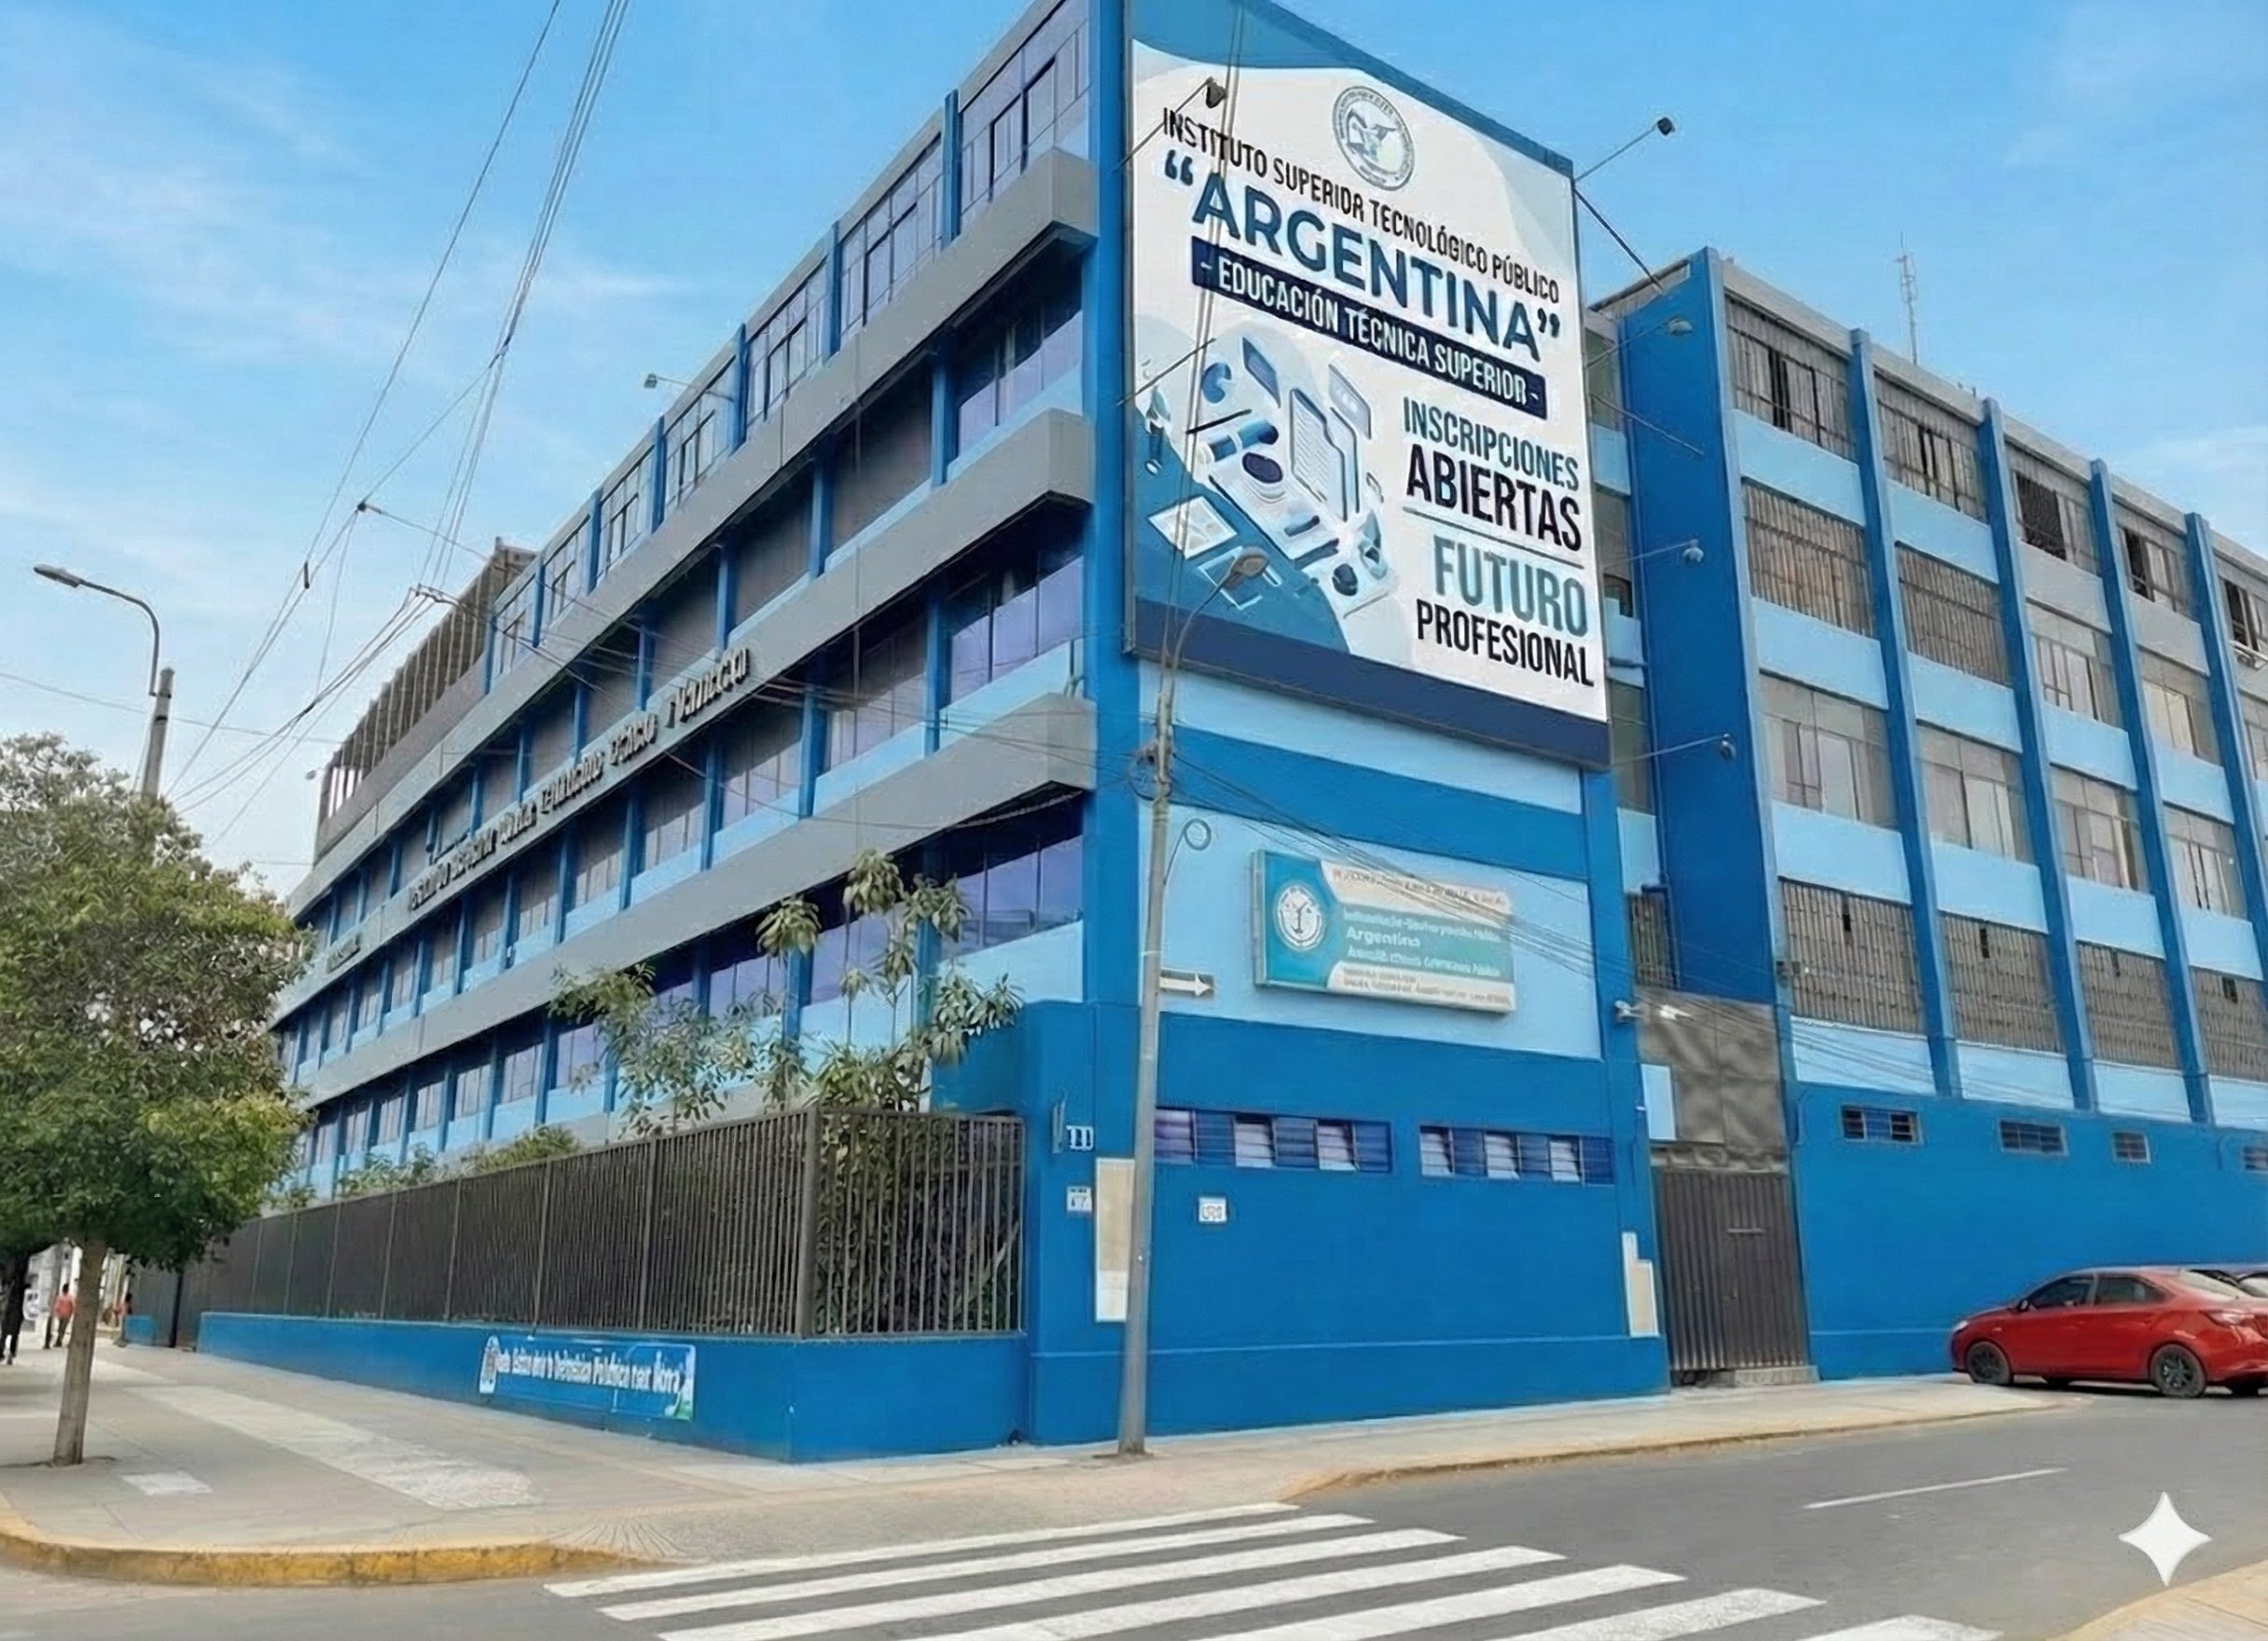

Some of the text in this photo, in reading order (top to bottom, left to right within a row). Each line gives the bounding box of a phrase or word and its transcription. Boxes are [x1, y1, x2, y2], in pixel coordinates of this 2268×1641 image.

[1163, 107, 1267, 178] INSTITUTO
[1369, 199, 1487, 274] TECNOLÓGICO
[1492, 255, 1559, 304] PÚBLICO
[1344, 306, 1431, 368] TÉCNICA
[1404, 396, 1579, 491] INSCRIPCIONES
[1406, 443, 1582, 552] ABIERTAS
[1433, 534, 1588, 638] FUTURO
[1417, 598, 1595, 687] PROFESIONAL
